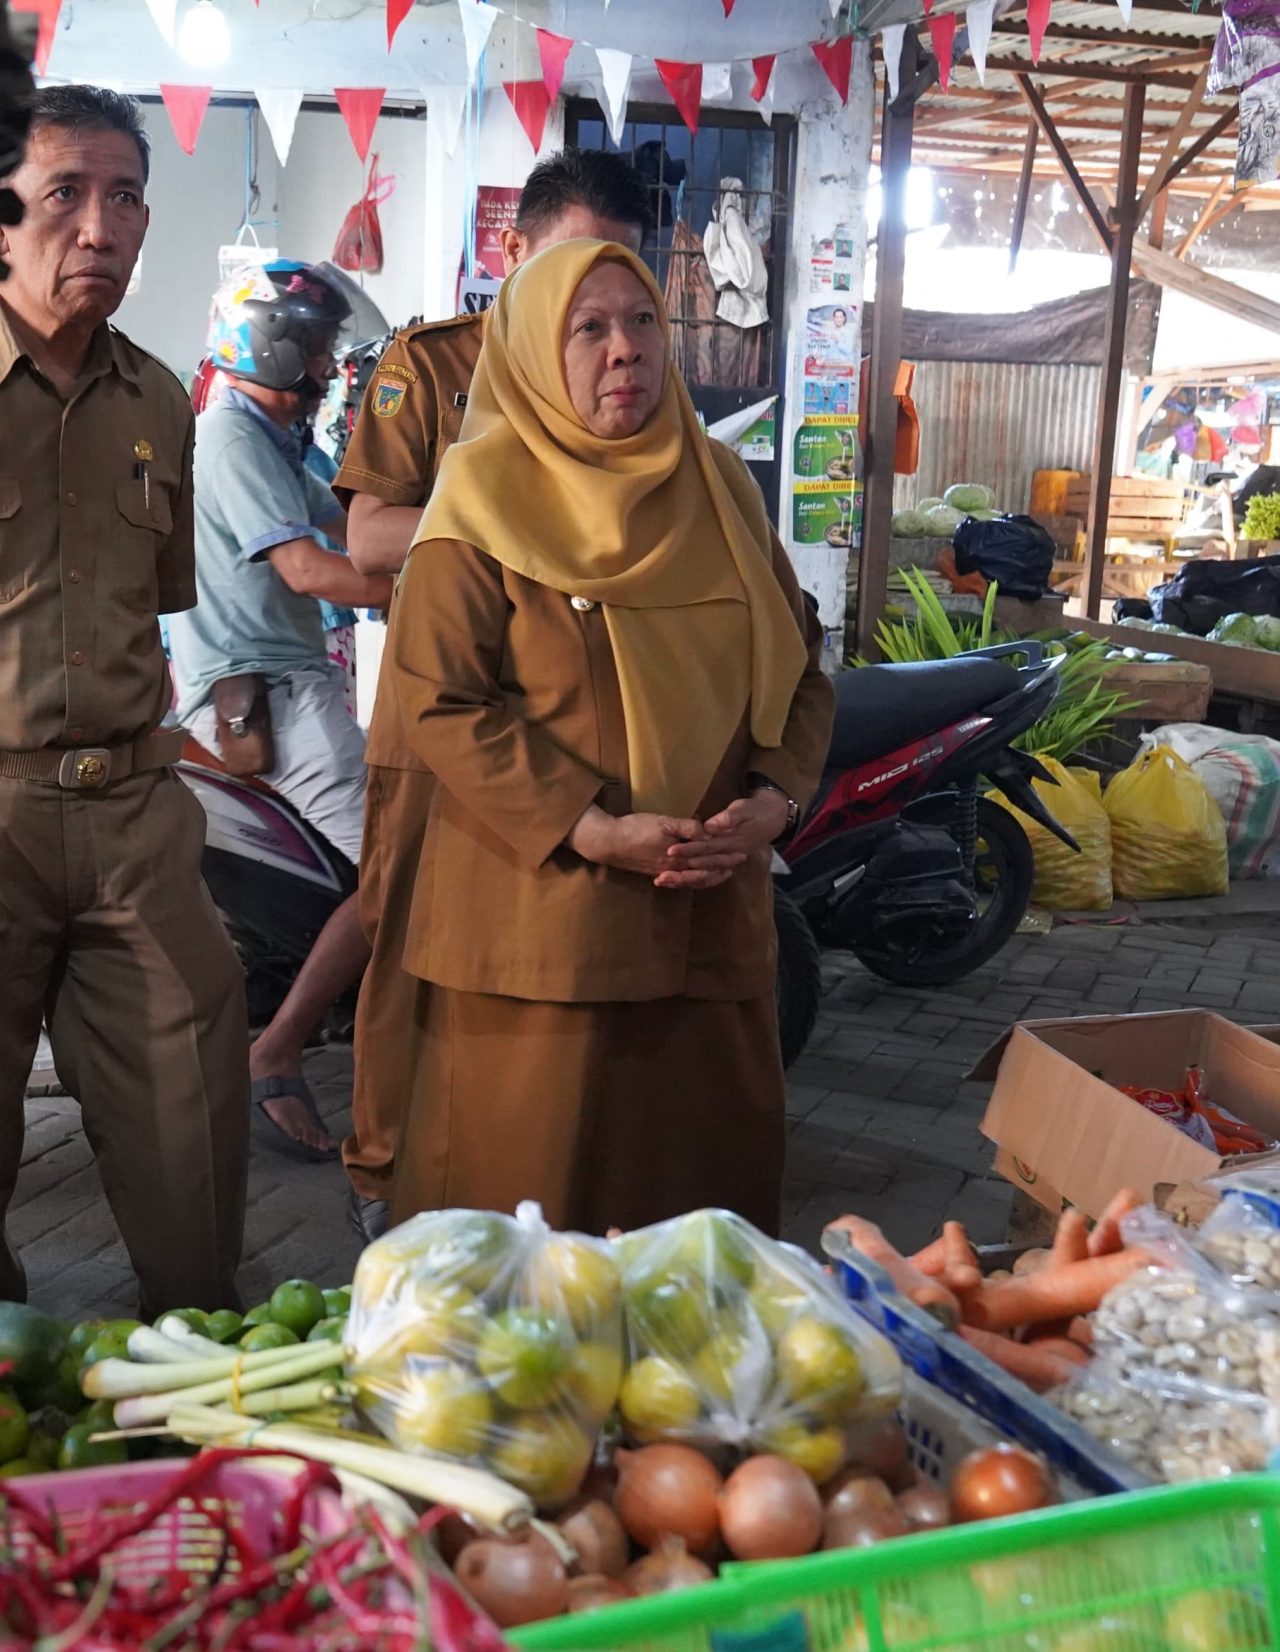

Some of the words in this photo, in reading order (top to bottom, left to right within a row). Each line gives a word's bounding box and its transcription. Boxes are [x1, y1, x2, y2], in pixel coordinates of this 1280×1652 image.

[805, 416, 831, 424] DAPAT
[799, 434, 827, 443] Santan
[804, 483, 830, 491] DAPAT
[799, 501, 826, 510] Santan
[912, 746, 944, 766] 125
